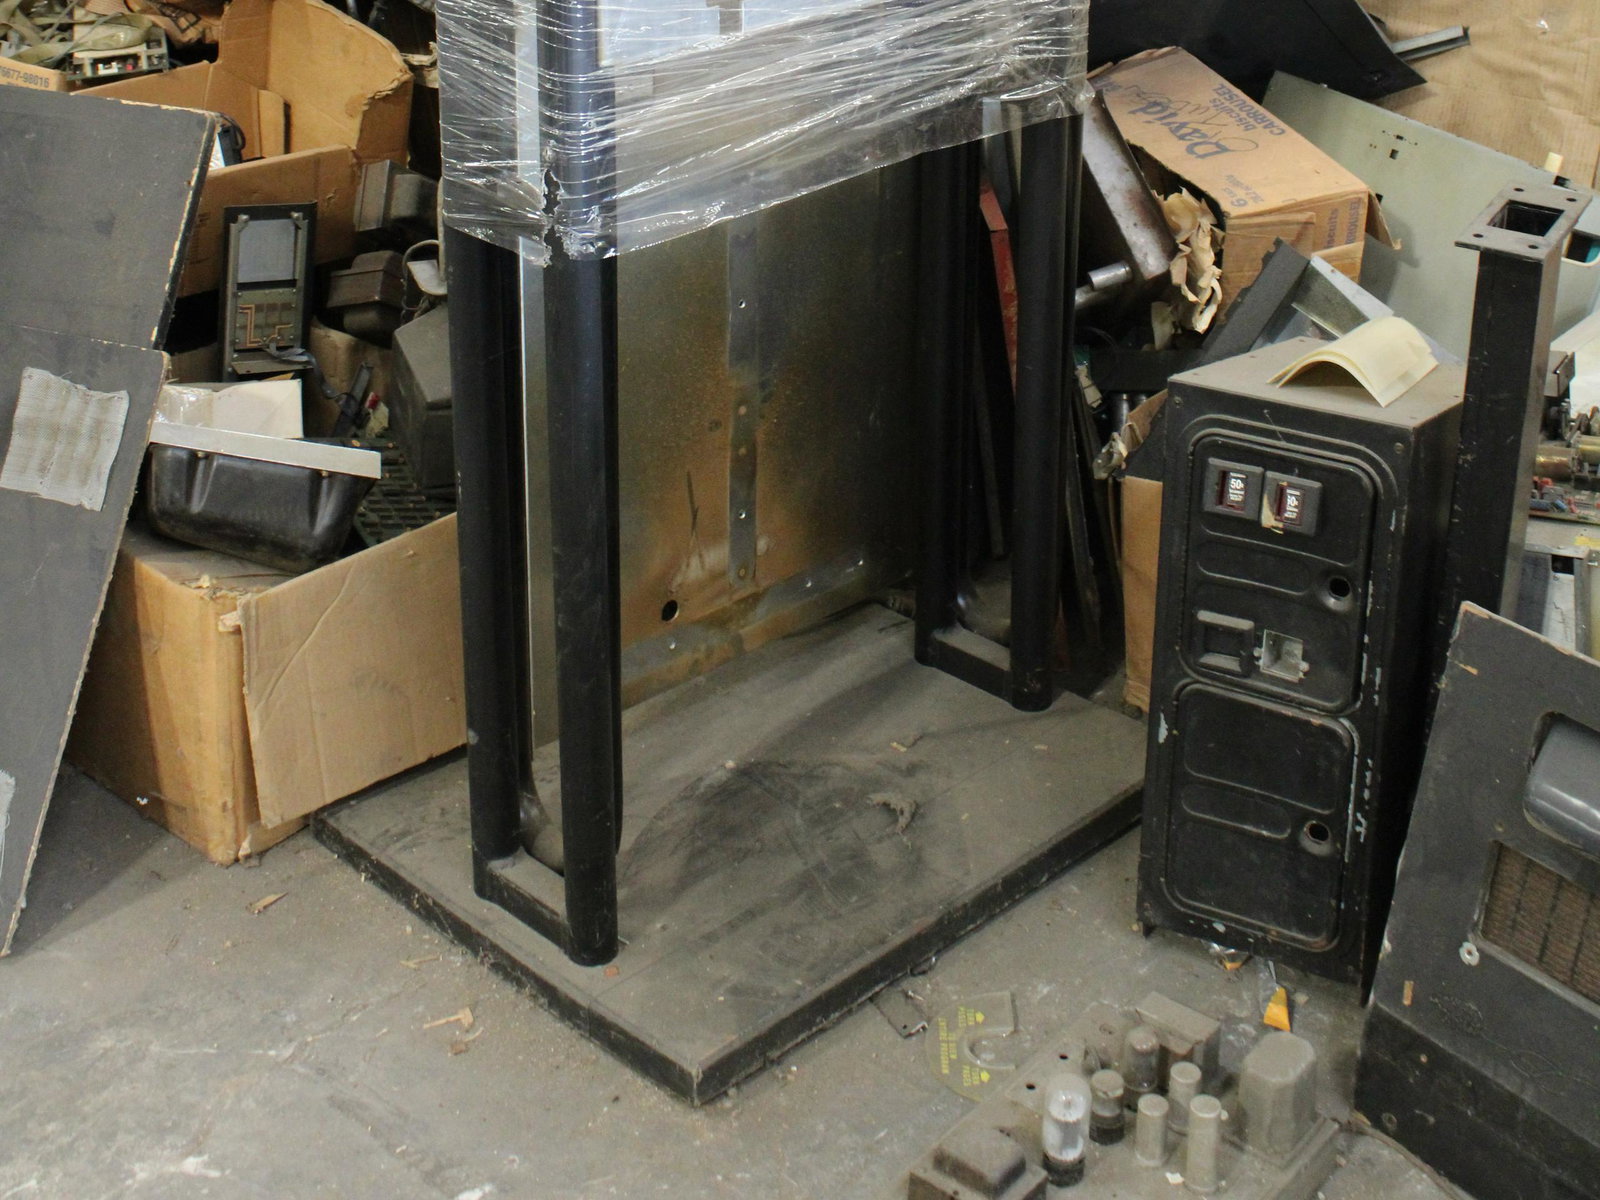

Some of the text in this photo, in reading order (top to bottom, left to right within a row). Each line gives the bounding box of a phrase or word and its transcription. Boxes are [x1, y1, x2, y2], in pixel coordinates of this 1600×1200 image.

[1127, 101, 1232, 160] David
[1208, 97, 1259, 132] biscuits
[1211, 83, 1286, 137] CARROUSEL
